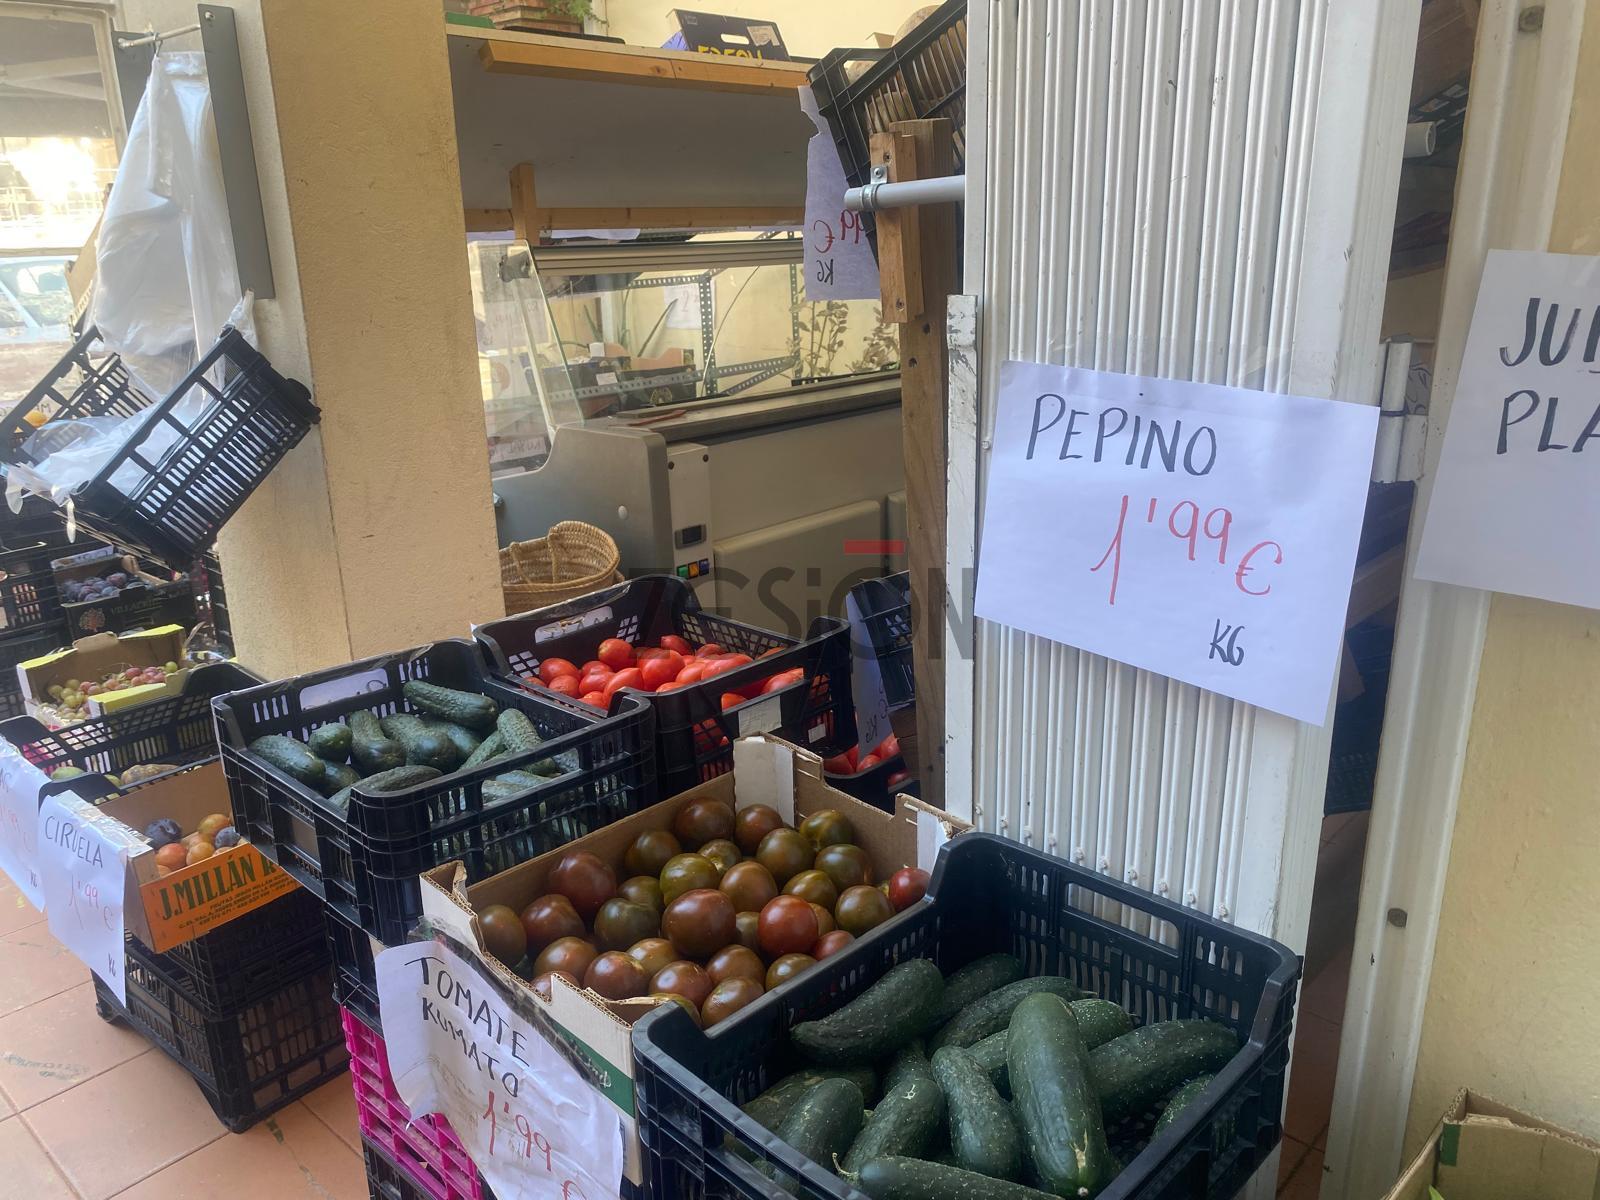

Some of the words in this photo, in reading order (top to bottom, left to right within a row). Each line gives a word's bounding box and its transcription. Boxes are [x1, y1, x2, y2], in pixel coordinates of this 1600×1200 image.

[1026, 393, 1217, 476] PEPINO
[1208, 618, 1245, 666] KG
[44, 815, 103, 869] CIRUELA
[159, 854, 257, 921] J.MILLÁN
[404, 956, 530, 1068] TOMATE
[422, 996, 519, 1098] KUMATO
